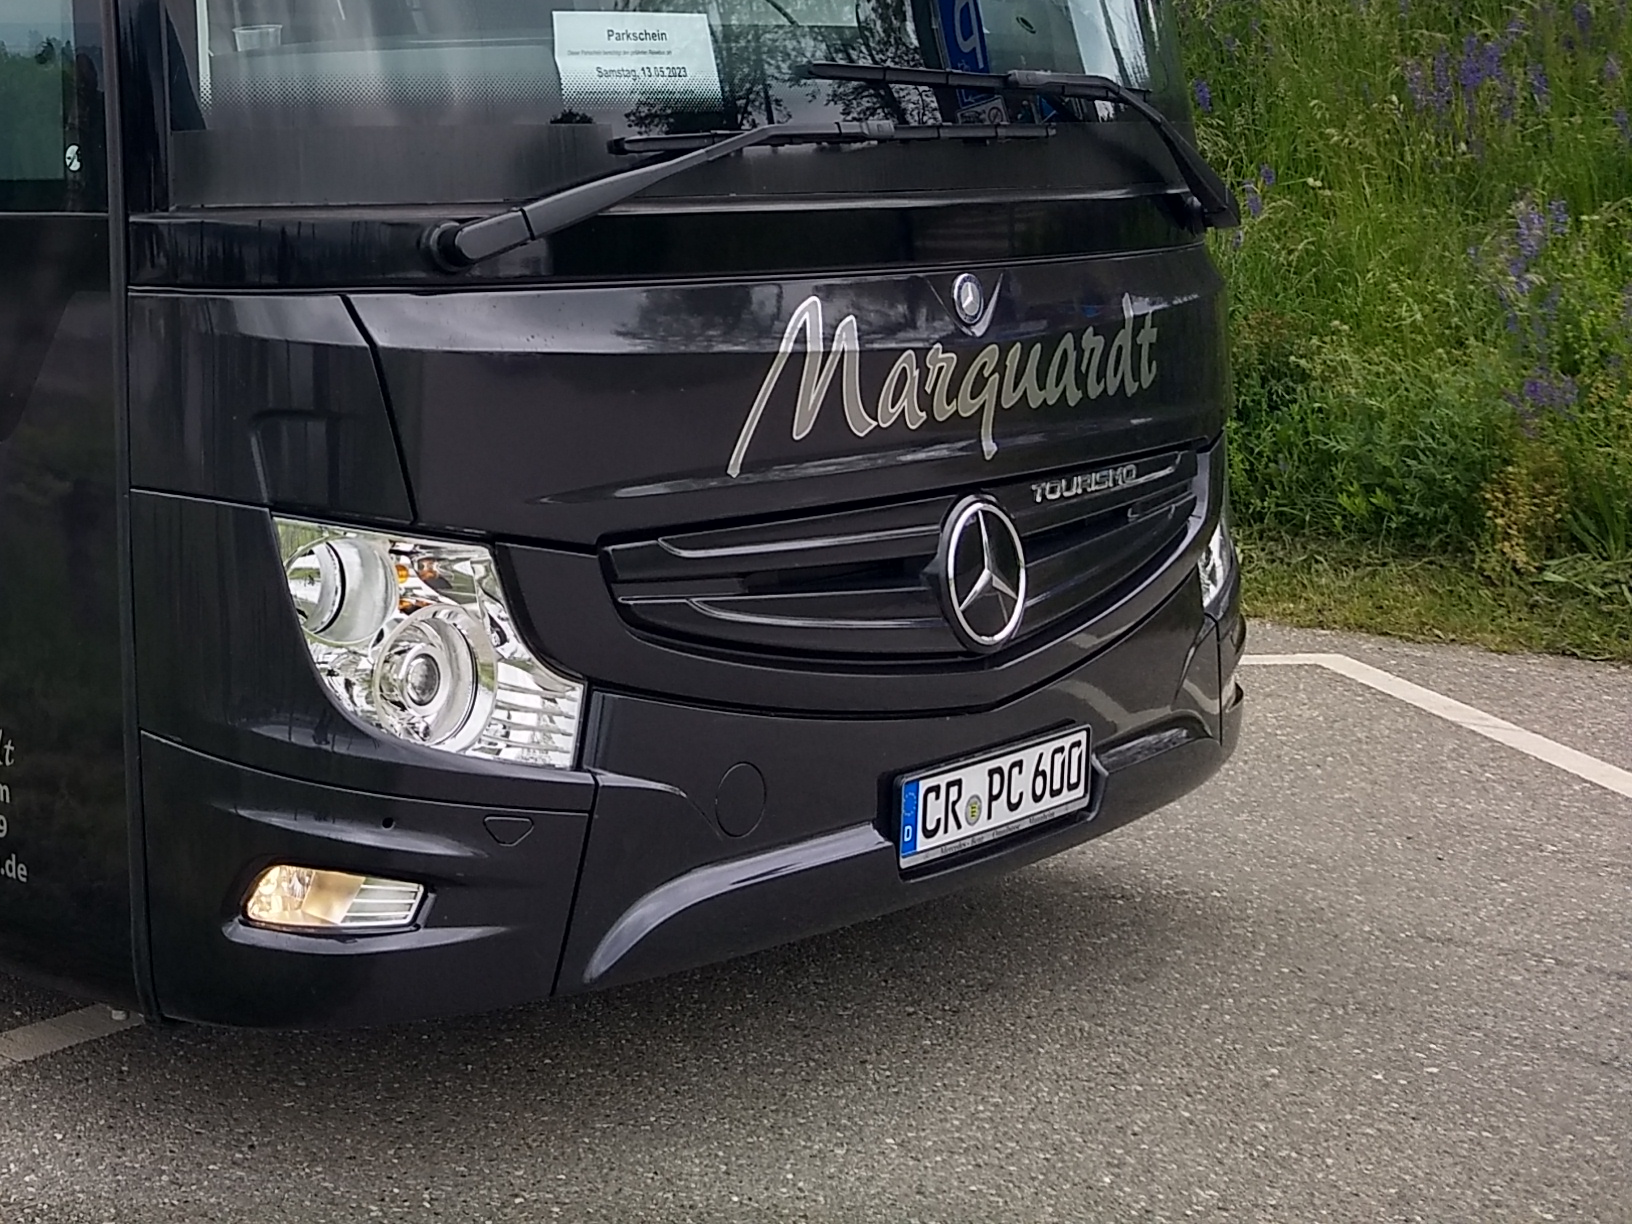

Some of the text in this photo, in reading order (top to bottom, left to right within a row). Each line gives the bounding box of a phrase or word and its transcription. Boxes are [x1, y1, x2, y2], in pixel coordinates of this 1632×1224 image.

[606, 29, 668, 42] Parkschein
[726, 292, 1158, 478] Marquardt
[1031, 465, 1136, 503] TOURISMO
[921, 739, 1083, 839] CR PC 600
[903, 825, 913, 843] D
